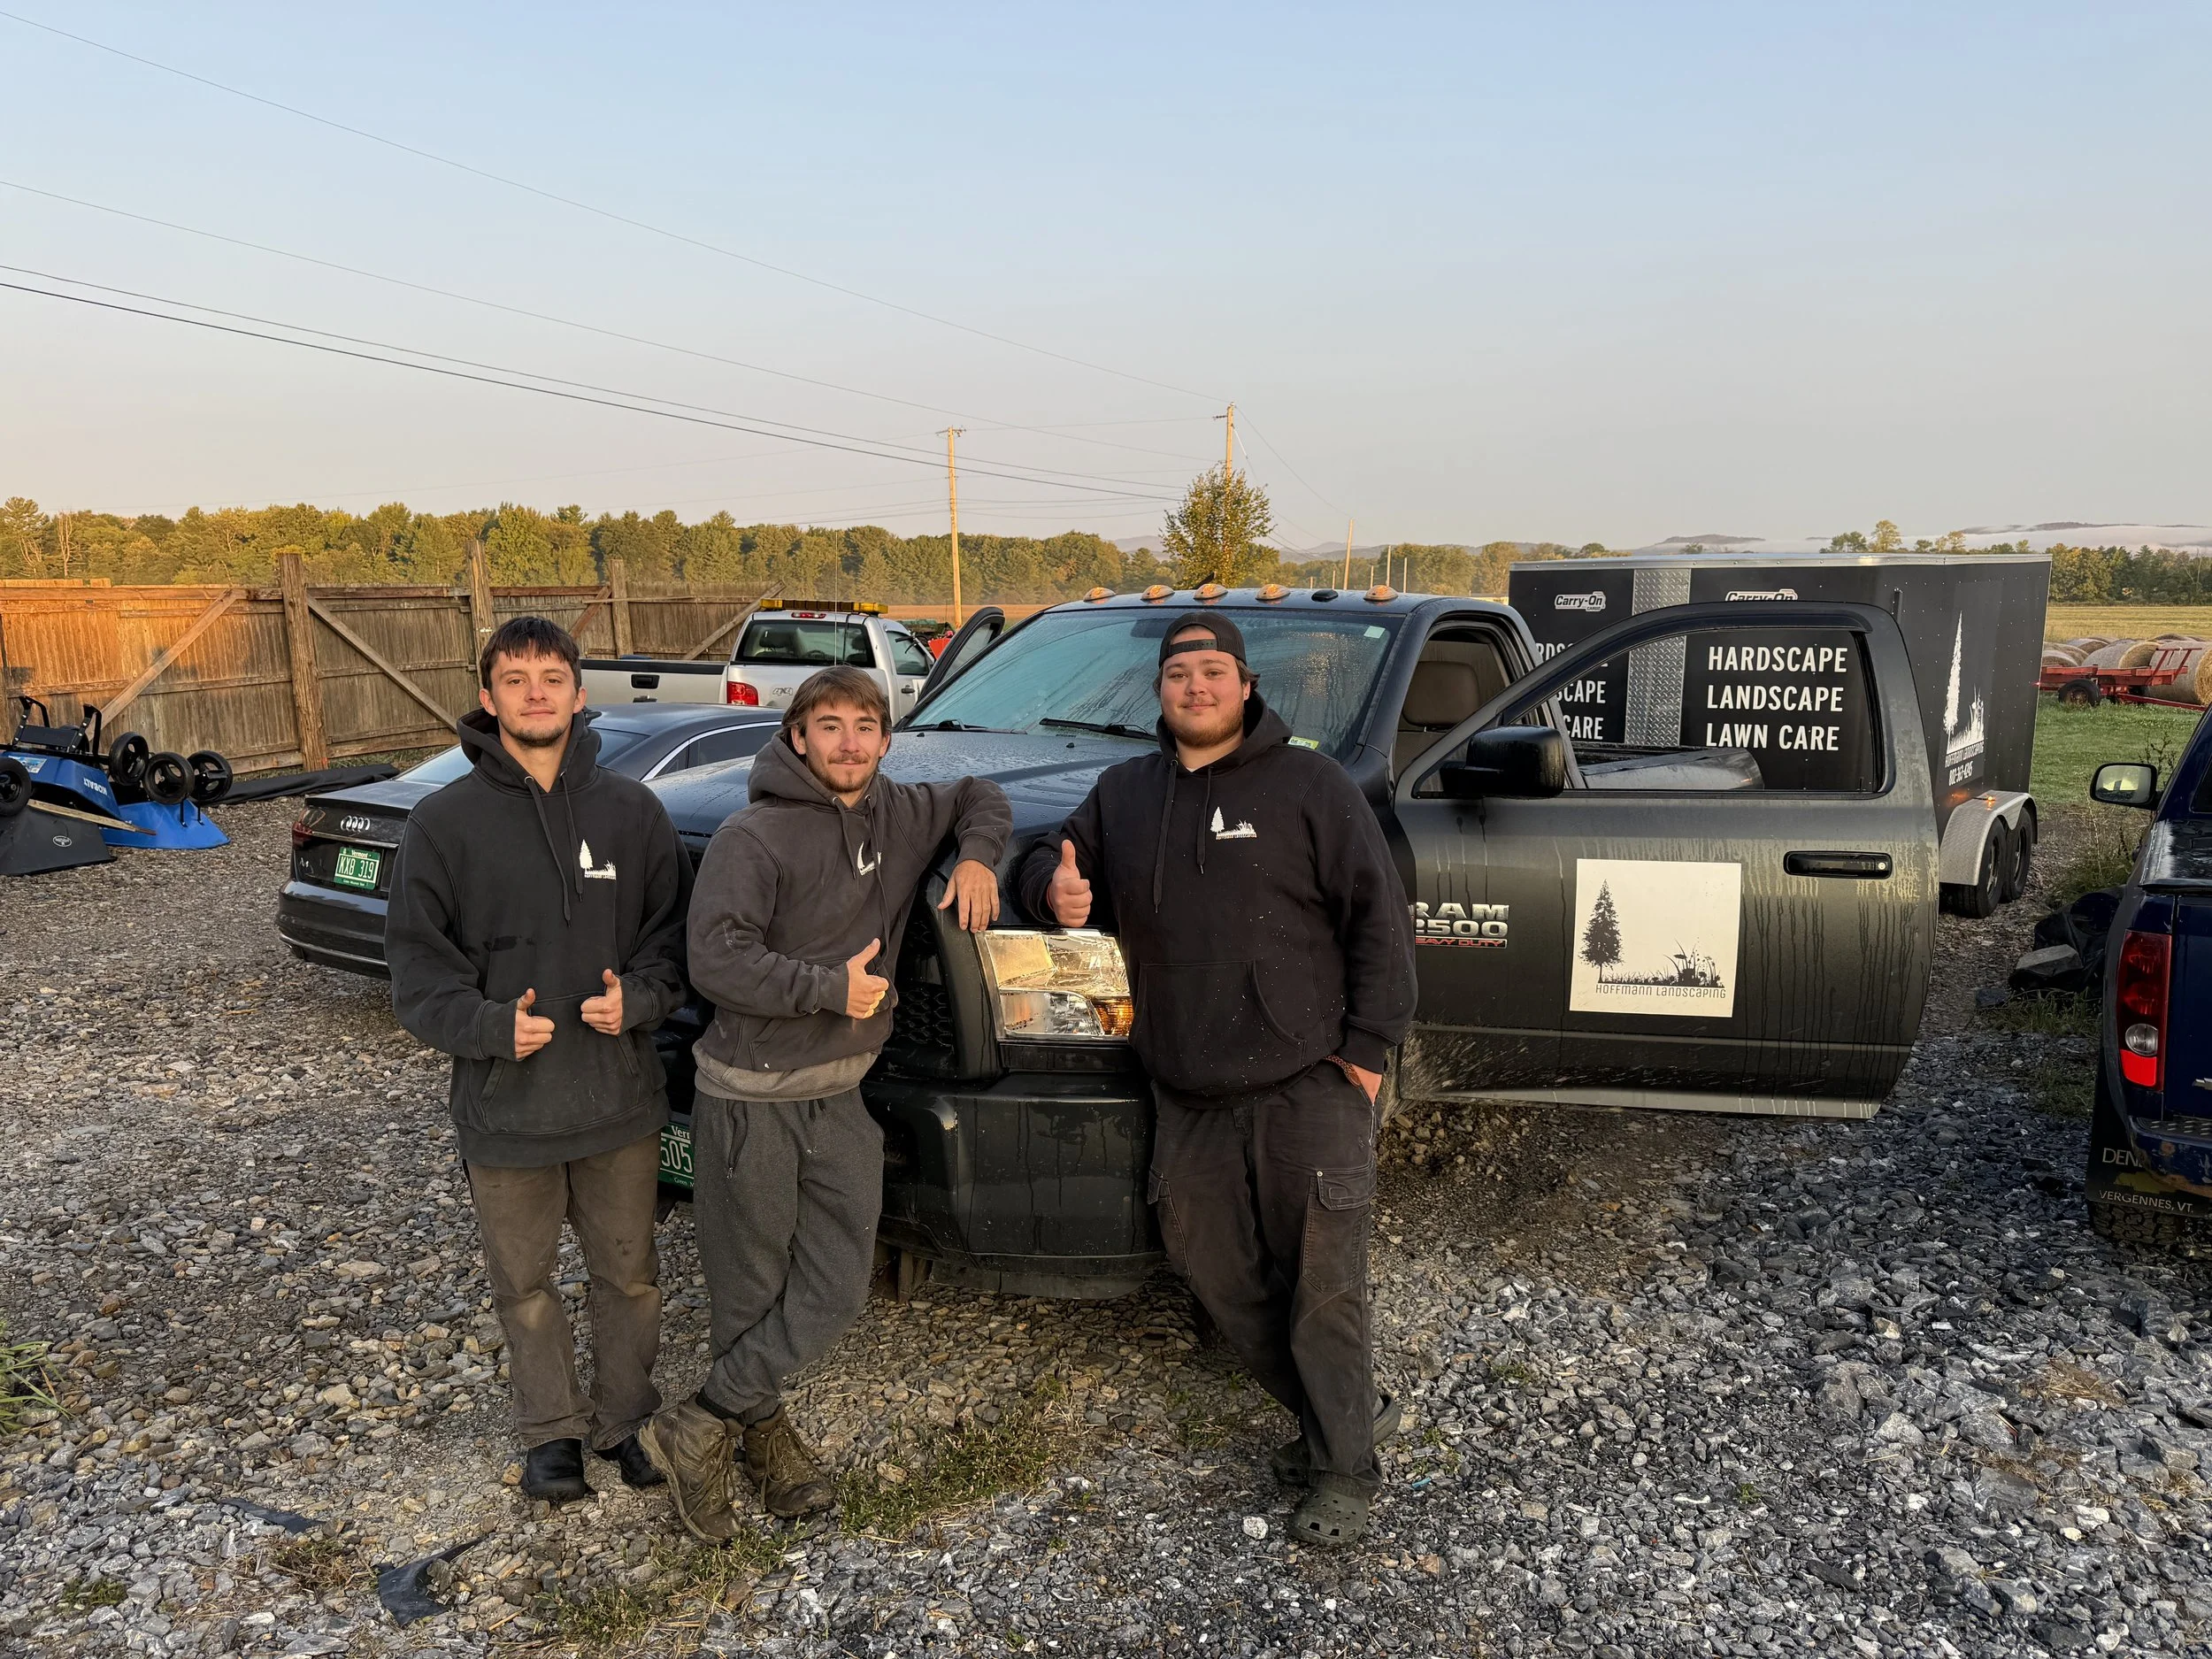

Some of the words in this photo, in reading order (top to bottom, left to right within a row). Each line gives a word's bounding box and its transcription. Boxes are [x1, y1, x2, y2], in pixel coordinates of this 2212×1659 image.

[1556, 595, 1603, 608] Carry-On
[1708, 646, 1848, 672] HARDSCAPE
[1707, 685, 1845, 712] LANDSCAPE
[1706, 723, 1769, 749] LAWN
[1778, 725, 1840, 752] CARE
[339, 856, 356, 876] KXB
[357, 859, 374, 879] 319
[1416, 902, 1509, 920] RAM
[2099, 1190, 2175, 1211] VERGENNES,
[2177, 1202, 2194, 1214] VT.
